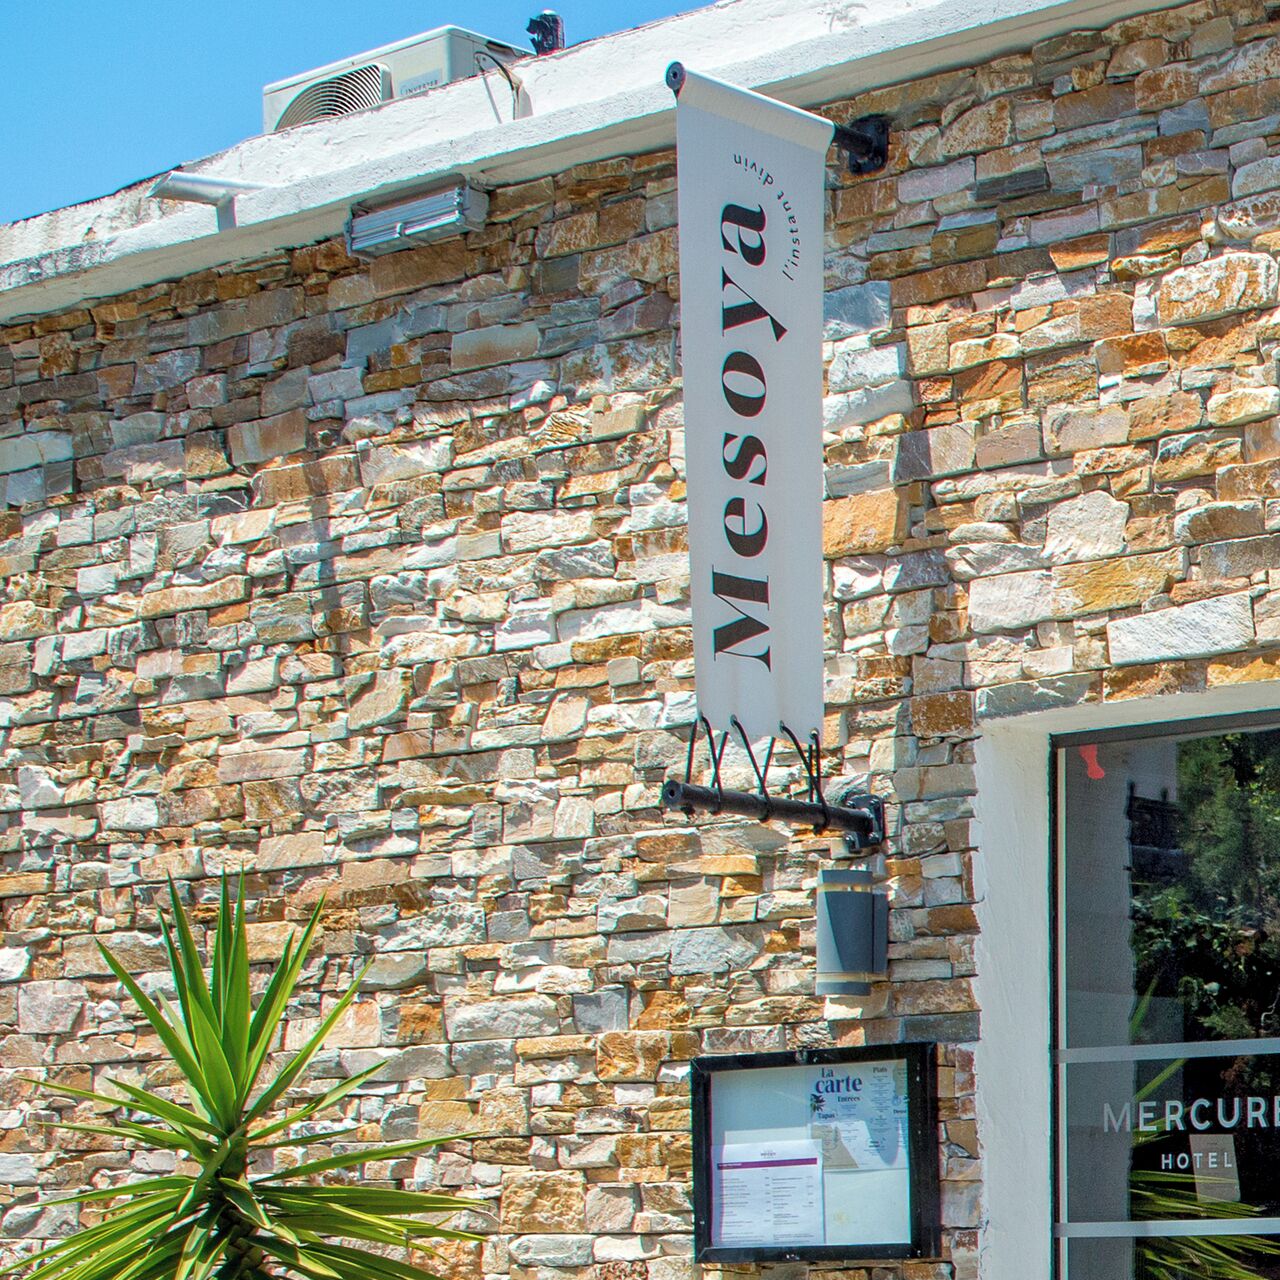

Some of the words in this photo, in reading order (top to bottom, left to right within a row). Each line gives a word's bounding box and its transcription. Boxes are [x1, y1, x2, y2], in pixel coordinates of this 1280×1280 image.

[733, 153, 774, 186] divin
[777, 190, 801, 281] l'instant
[711, 202, 787, 672] Mesoya
[815, 1075, 863, 1094] carte
[821, 1067, 834, 1078] La
[1161, 1151, 1233, 1170] HOTEL
